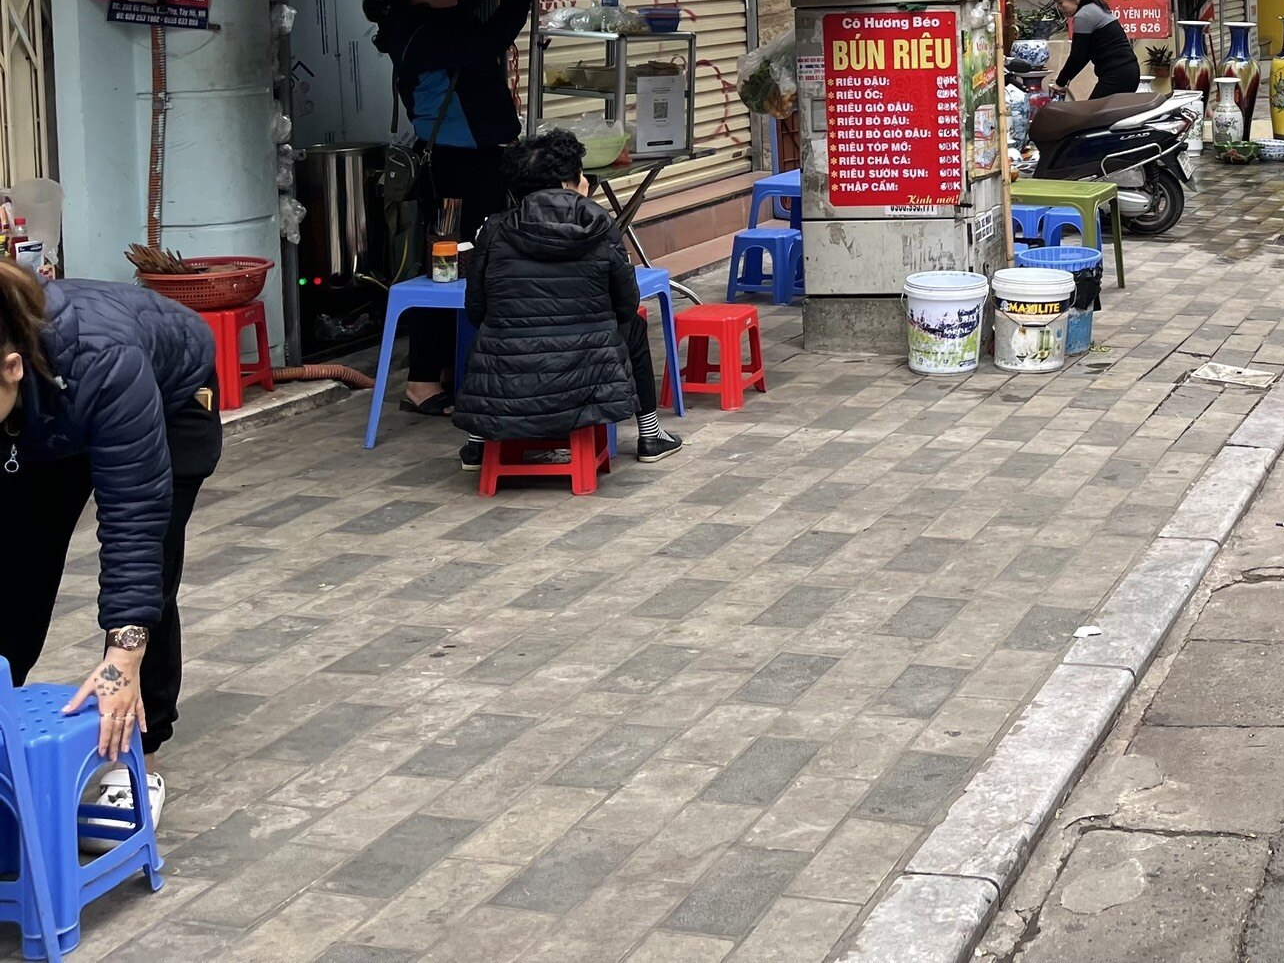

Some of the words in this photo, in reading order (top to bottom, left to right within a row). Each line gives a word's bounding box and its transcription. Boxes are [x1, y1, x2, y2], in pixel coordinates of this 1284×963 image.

[1123, 6, 1141, 19] YÊN
[1142, 9, 1161, 22] PHỤ
[842, 17, 861, 30] Cô
[864, 17, 910, 32] Hương
[912, 16, 940, 28] Béo
[1121, 23, 1137, 34] 35
[1140, 23, 1161, 33] 626
[833, 33, 885, 71] BÚN
[894, 31, 951, 70] RIÊU
[835, 75, 861, 87] RIÊU
[864, 75, 890, 88] ĐẬU:
[836, 88, 862, 100] RIÊU
[864, 87, 883, 100] ỐC:
[836, 102, 862, 113] RIÊU
[865, 102, 884, 112] GIÒ
[887, 102, 914, 114] ĐẬU:
[837, 115, 862, 126] RIÊU
[866, 115, 880, 126] BÒ
[883, 115, 910, 127] ĐẬU:
[837, 128, 863, 139] RIÊU
[866, 128, 880, 139] BÒ
[884, 128, 902, 138] GIÒ
[905, 128, 932, 140] ĐẬU:
[1120, 132, 1151, 141] LEAD
[838, 141, 864, 152] RIÊU
[866, 141, 889, 152] TÓP
[839, 155, 864, 165] RIÊU
[892, 154, 911, 165] CÁ:
[839, 168, 865, 178] RIÊU
[869, 167, 899, 178] SƯỜN
[902, 168, 929, 179] SỤN:
[840, 182, 869, 193] THẬP
[1008, 301, 1060, 315] MAXILITE
